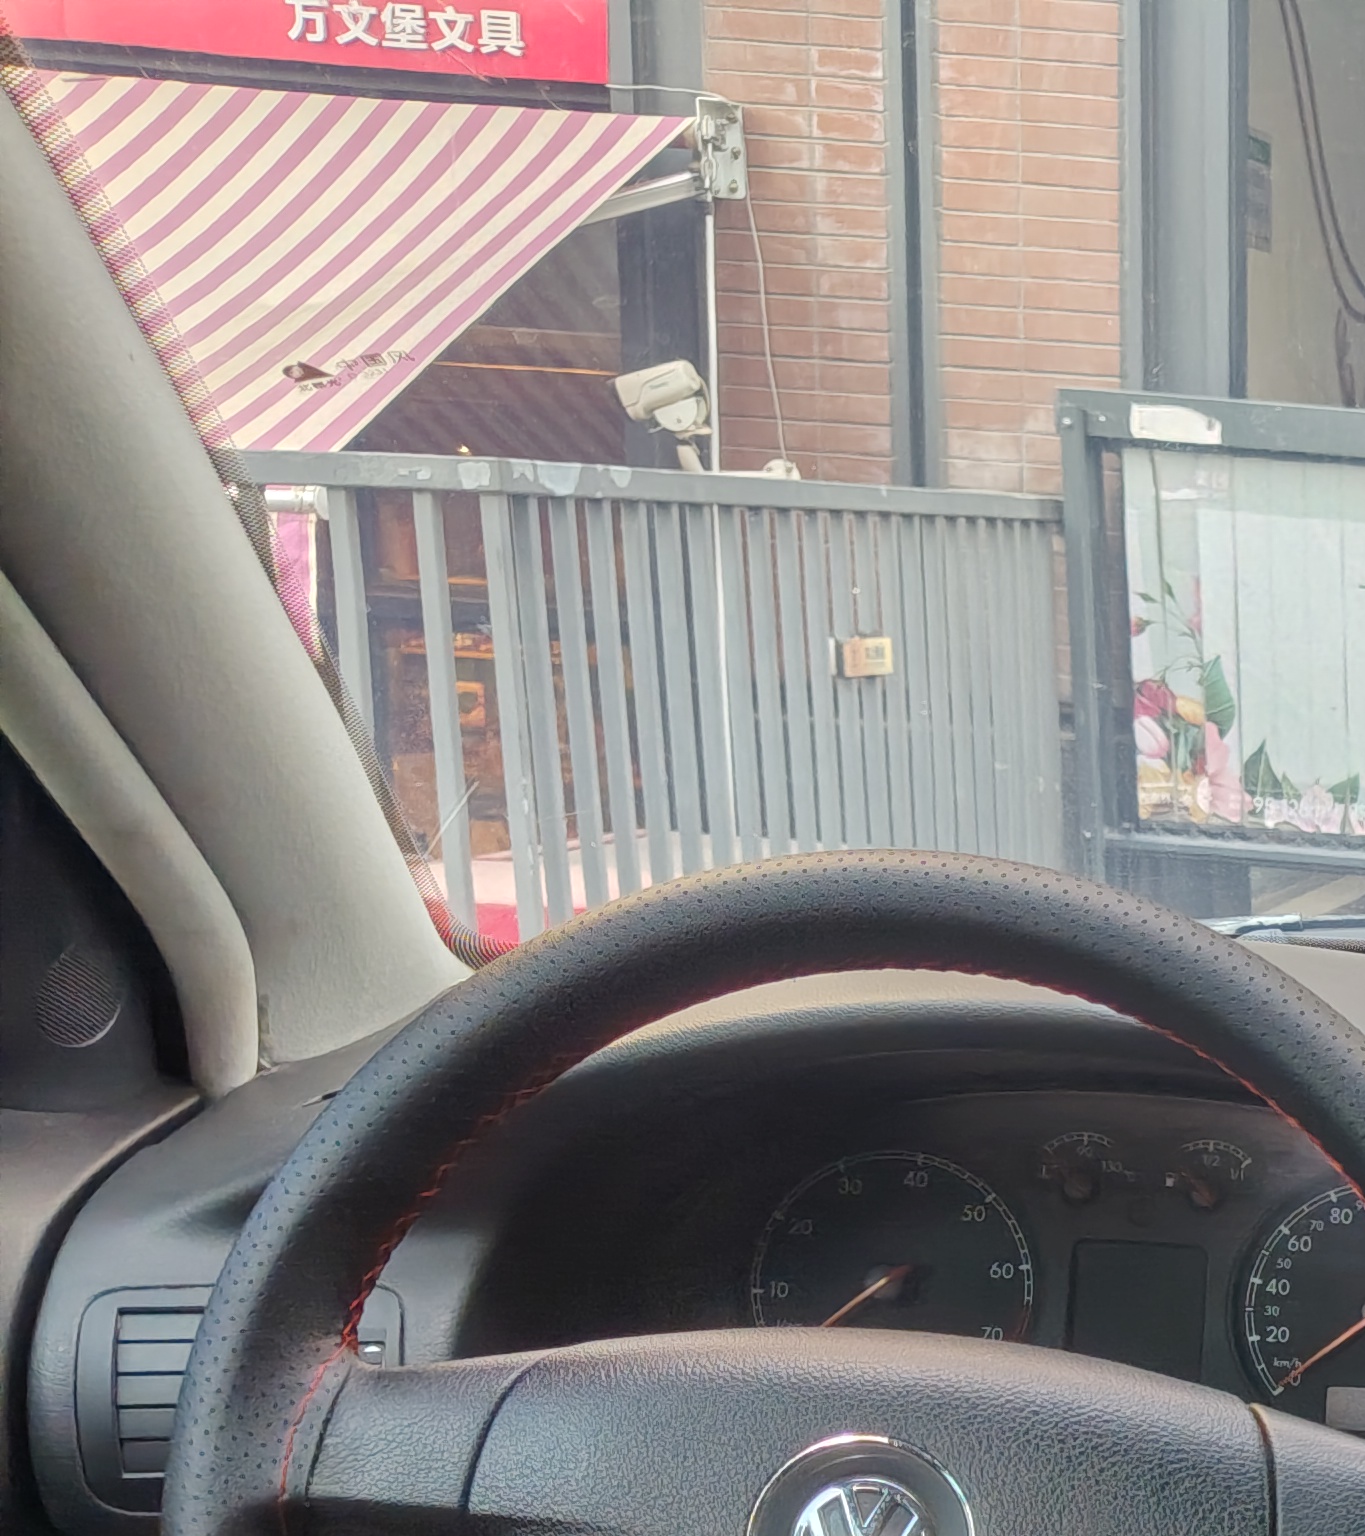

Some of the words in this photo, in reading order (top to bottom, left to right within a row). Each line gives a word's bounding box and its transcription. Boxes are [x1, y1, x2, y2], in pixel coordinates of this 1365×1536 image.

[903, 1170, 928, 1188] 40
[960, 1205, 986, 1222] 50
[1329, 1207, 1353, 1225] 80
[1309, 1220, 1325, 1232] 70
[1287, 1235, 1312, 1252] 60
[989, 1262, 1014, 1279] 60
[1276, 1257, 1292, 1270] 50
[770, 1281, 789, 1298] 10
[1265, 1278, 1291, 1296] 40
[1263, 1305, 1280, 1317] 30
[1265, 1325, 1290, 1343] 20
